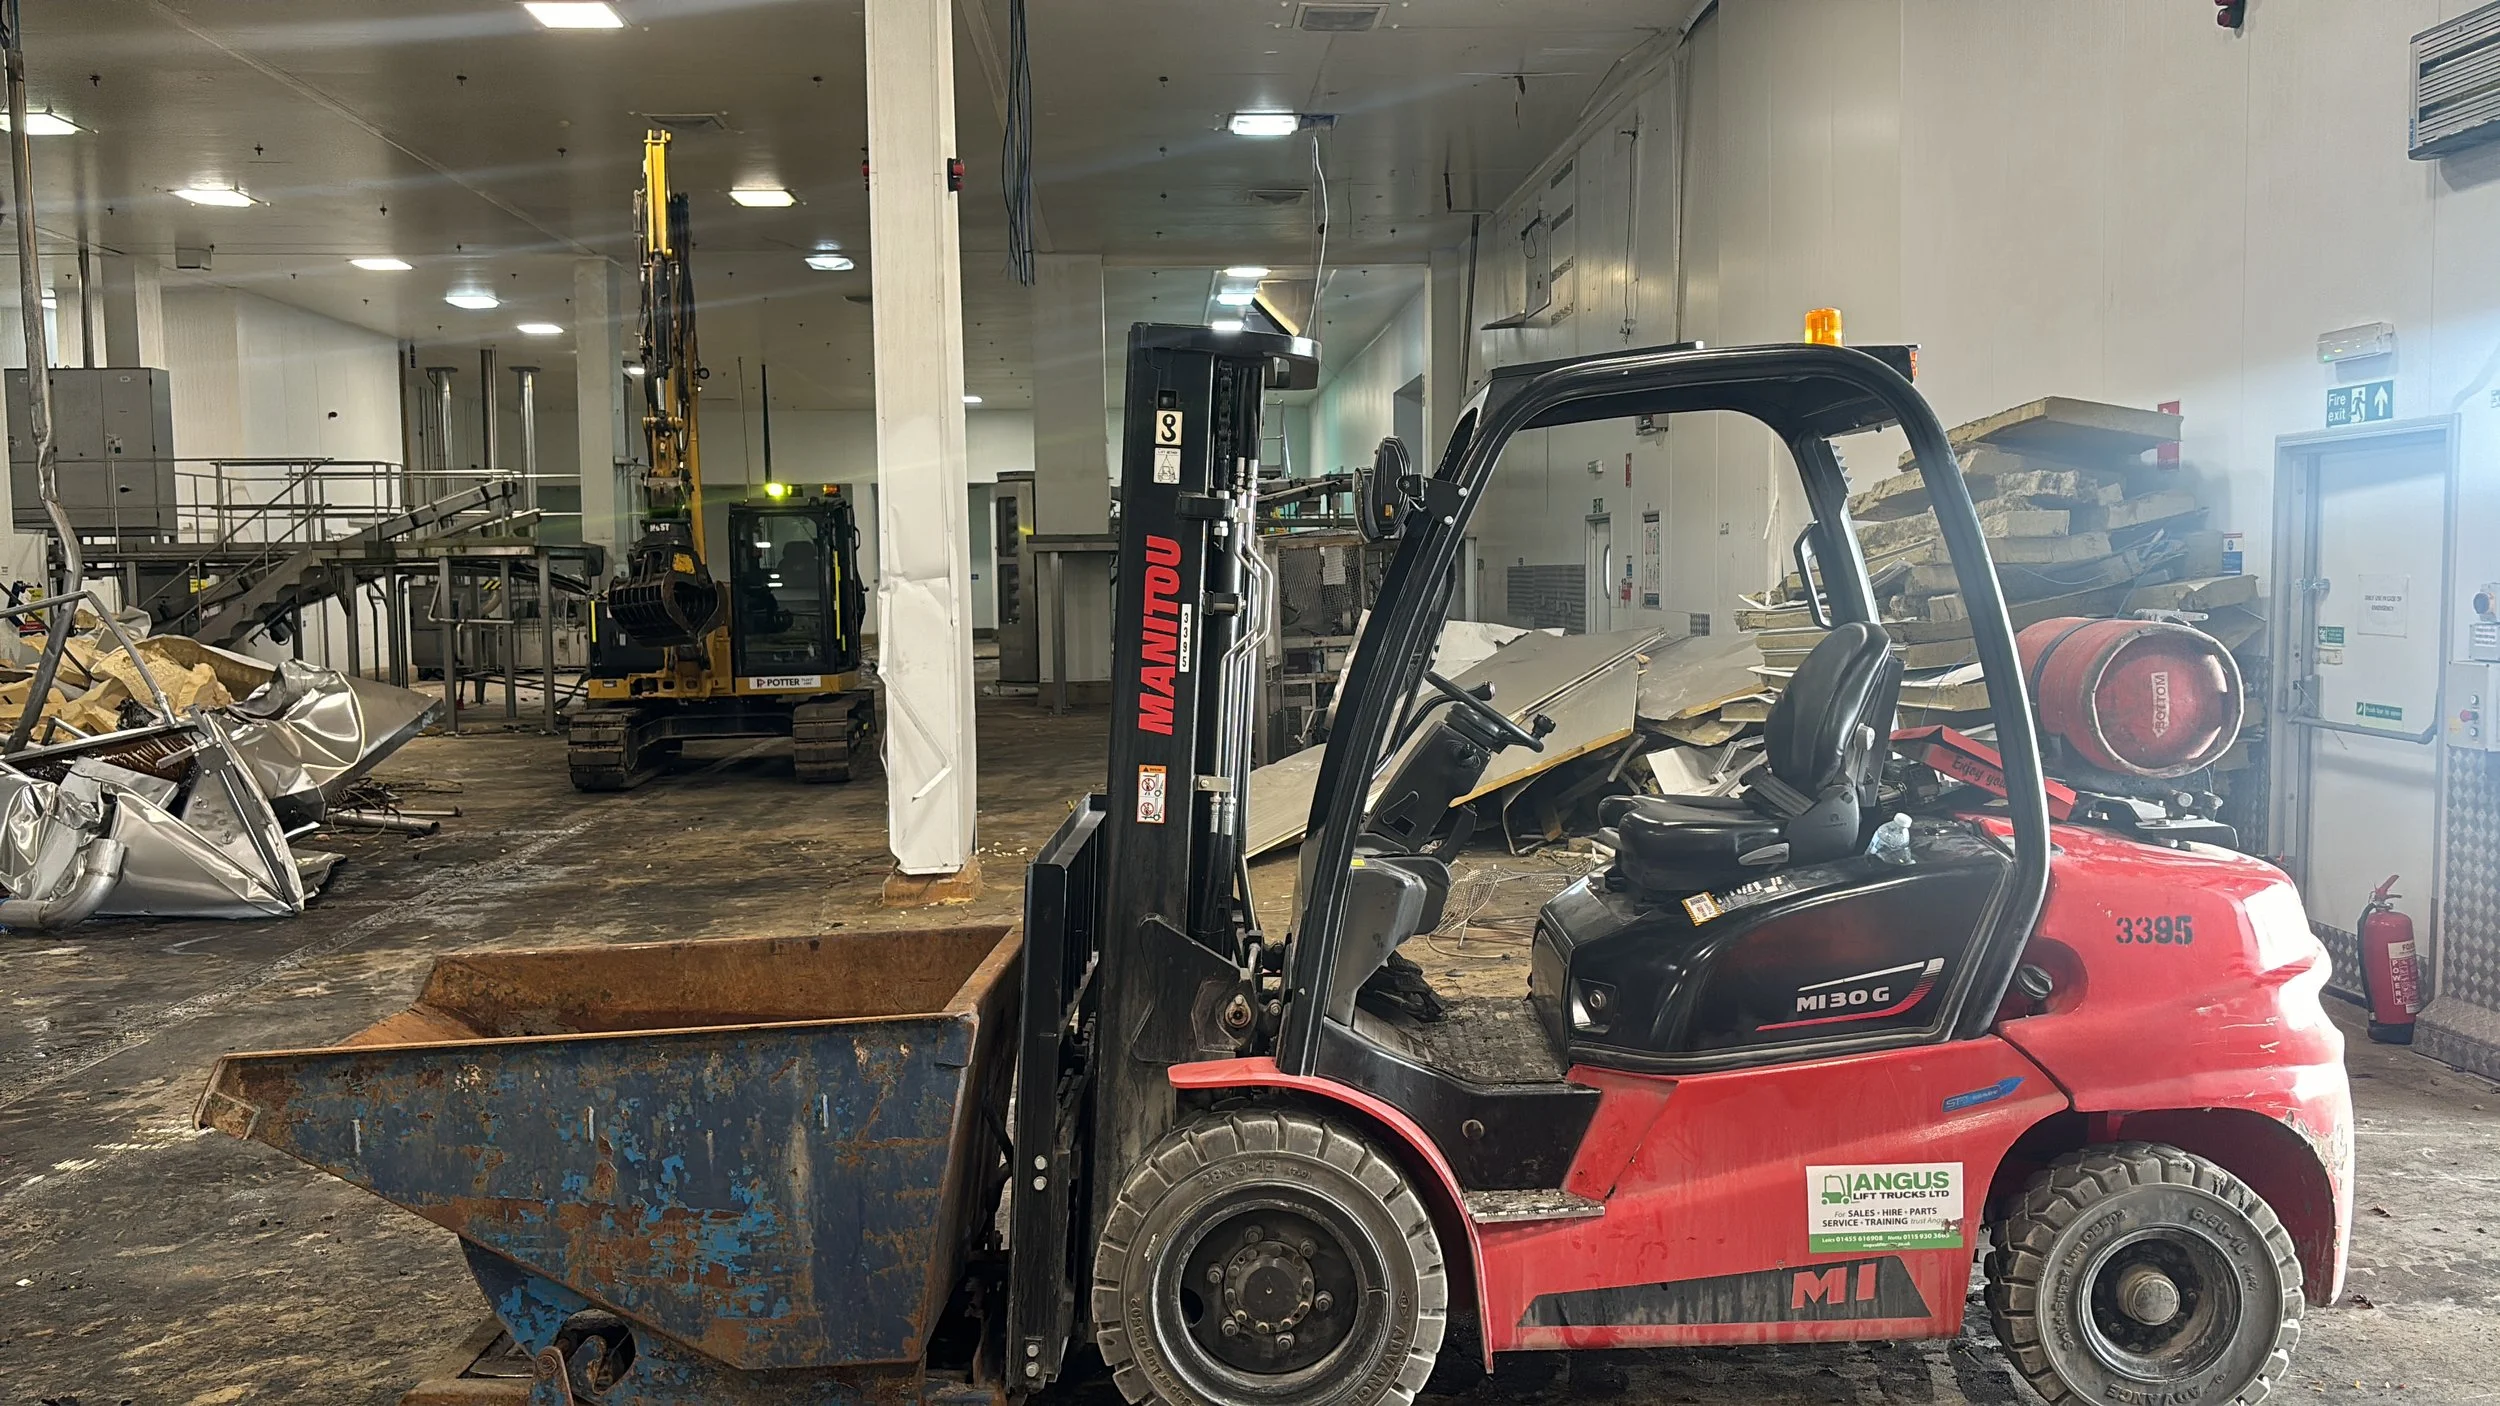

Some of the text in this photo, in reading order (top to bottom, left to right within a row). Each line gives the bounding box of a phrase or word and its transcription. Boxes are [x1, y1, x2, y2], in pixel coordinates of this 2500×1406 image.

[2328, 393, 2346, 407] Fire
[2328, 408, 2346, 422] exit
[1138, 535, 1183, 736] MANITOU
[767, 678, 800, 687] POTTER
[2154, 674, 2167, 730] BOTTOM
[2115, 914, 2194, 946] 3395
[1853, 1171, 1949, 1191] ANGUS
[1853, 1190, 1950, 1201] LIFT TRUCKS LTD
[1848, 1209, 1875, 1218] SALES
[1882, 1208, 1903, 1217] HIRE
[1909, 1207, 1937, 1216] PARTS
[1822, 1219, 1859, 1228] SERVICE
[1865, 1217, 1908, 1227] TRAINING
[1926, 1217, 1947, 1227] Angu
[1836, 1235, 1857, 1243] 01455
[1858, 1234, 1884, 1242] 616908
[1903, 1233, 1919, 1241] 0115
[1919, 1232, 1932, 1240] 930
[1791, 1263, 1877, 1310] MI
